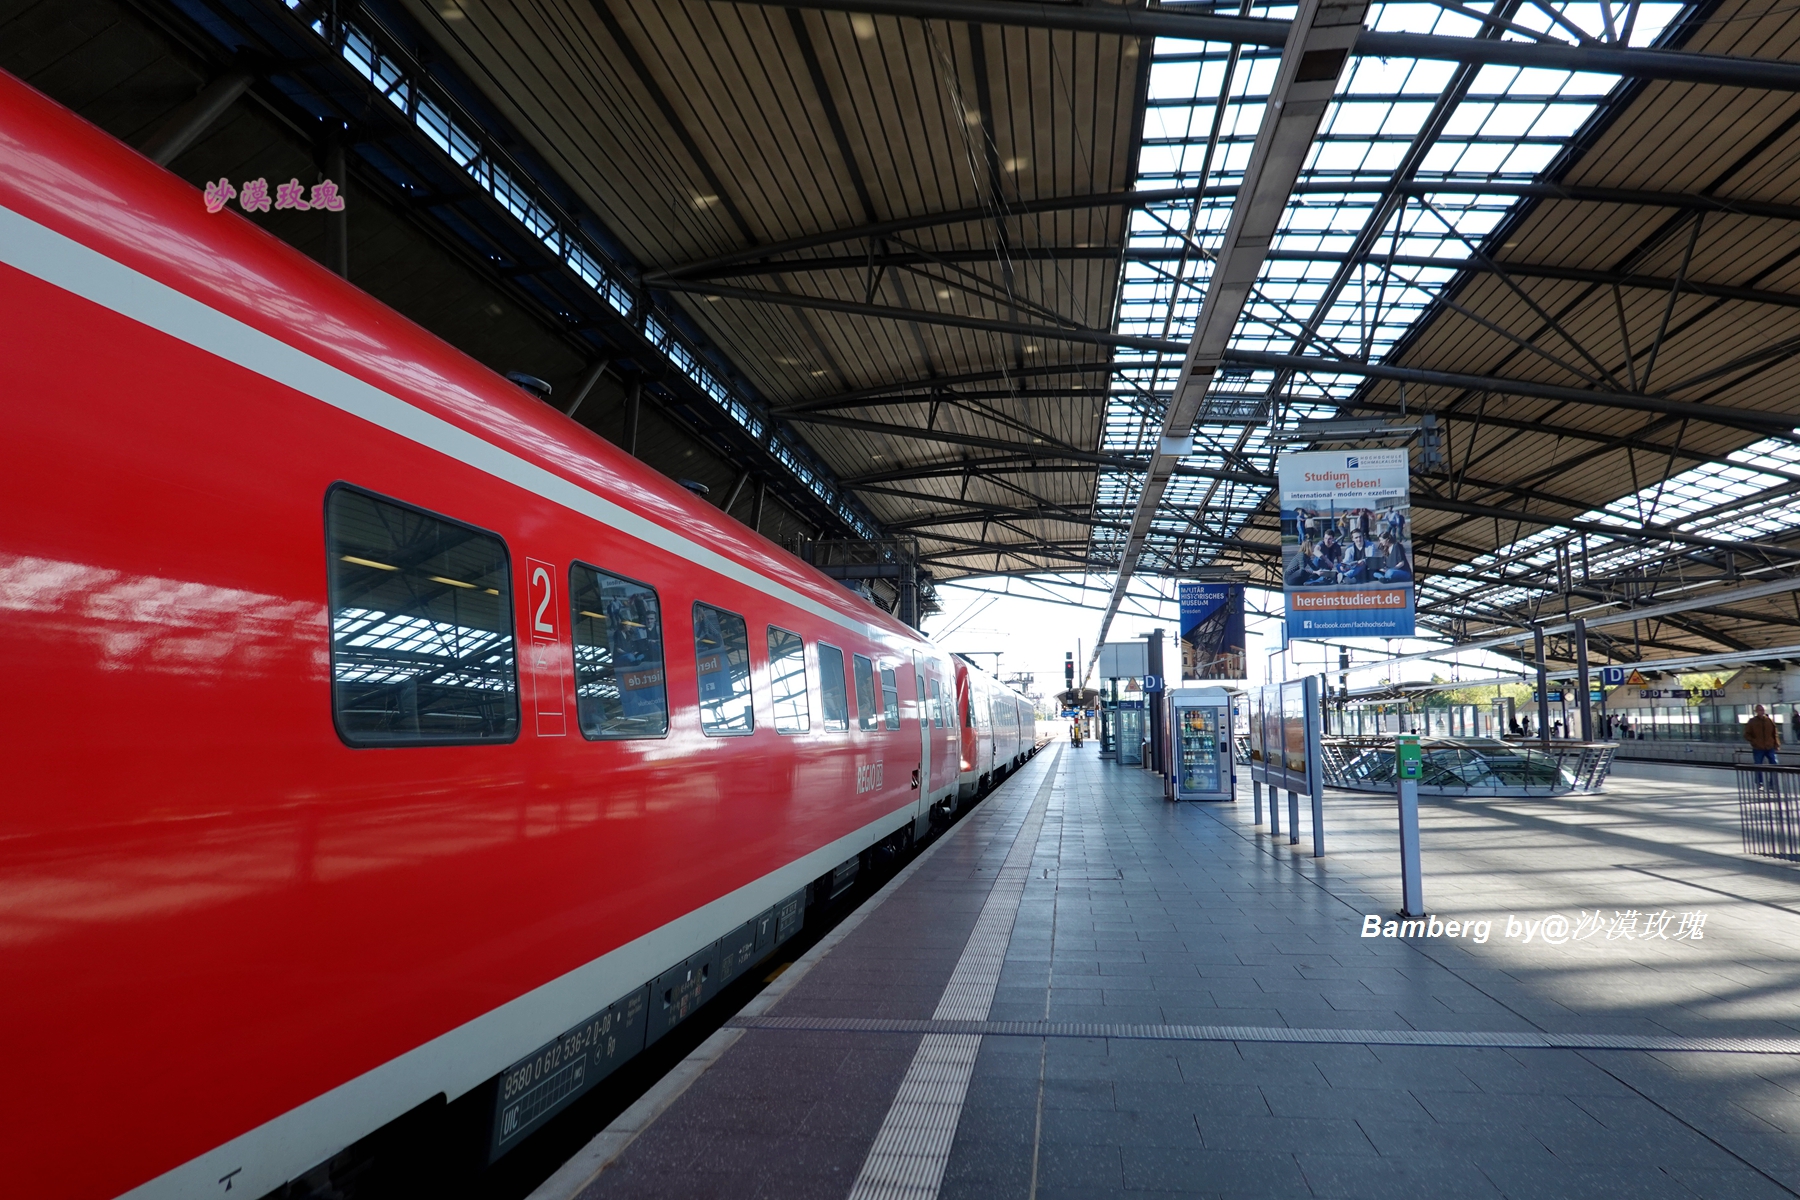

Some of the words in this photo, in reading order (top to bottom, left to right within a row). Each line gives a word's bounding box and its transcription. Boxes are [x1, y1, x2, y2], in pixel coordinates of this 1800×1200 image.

[1305, 471, 1350, 481] Studium
[1335, 478, 1381, 489] erleben!
[532, 567, 554, 634] 2
[1296, 592, 1400, 607] hereinstudiert.de
[1145, 675, 1156, 689] D
[1610, 668, 1622, 682] D
[1640, 689, 1647, 698] 9
[857, 764, 875, 794] REGIO
[504, 1063, 532, 1100] 9580
[534, 1056, 542, 1081] 0
[544, 1044, 562, 1075] 612
[563, 1025, 592, 1061] 536-2
[503, 1105, 520, 1136] UIC
